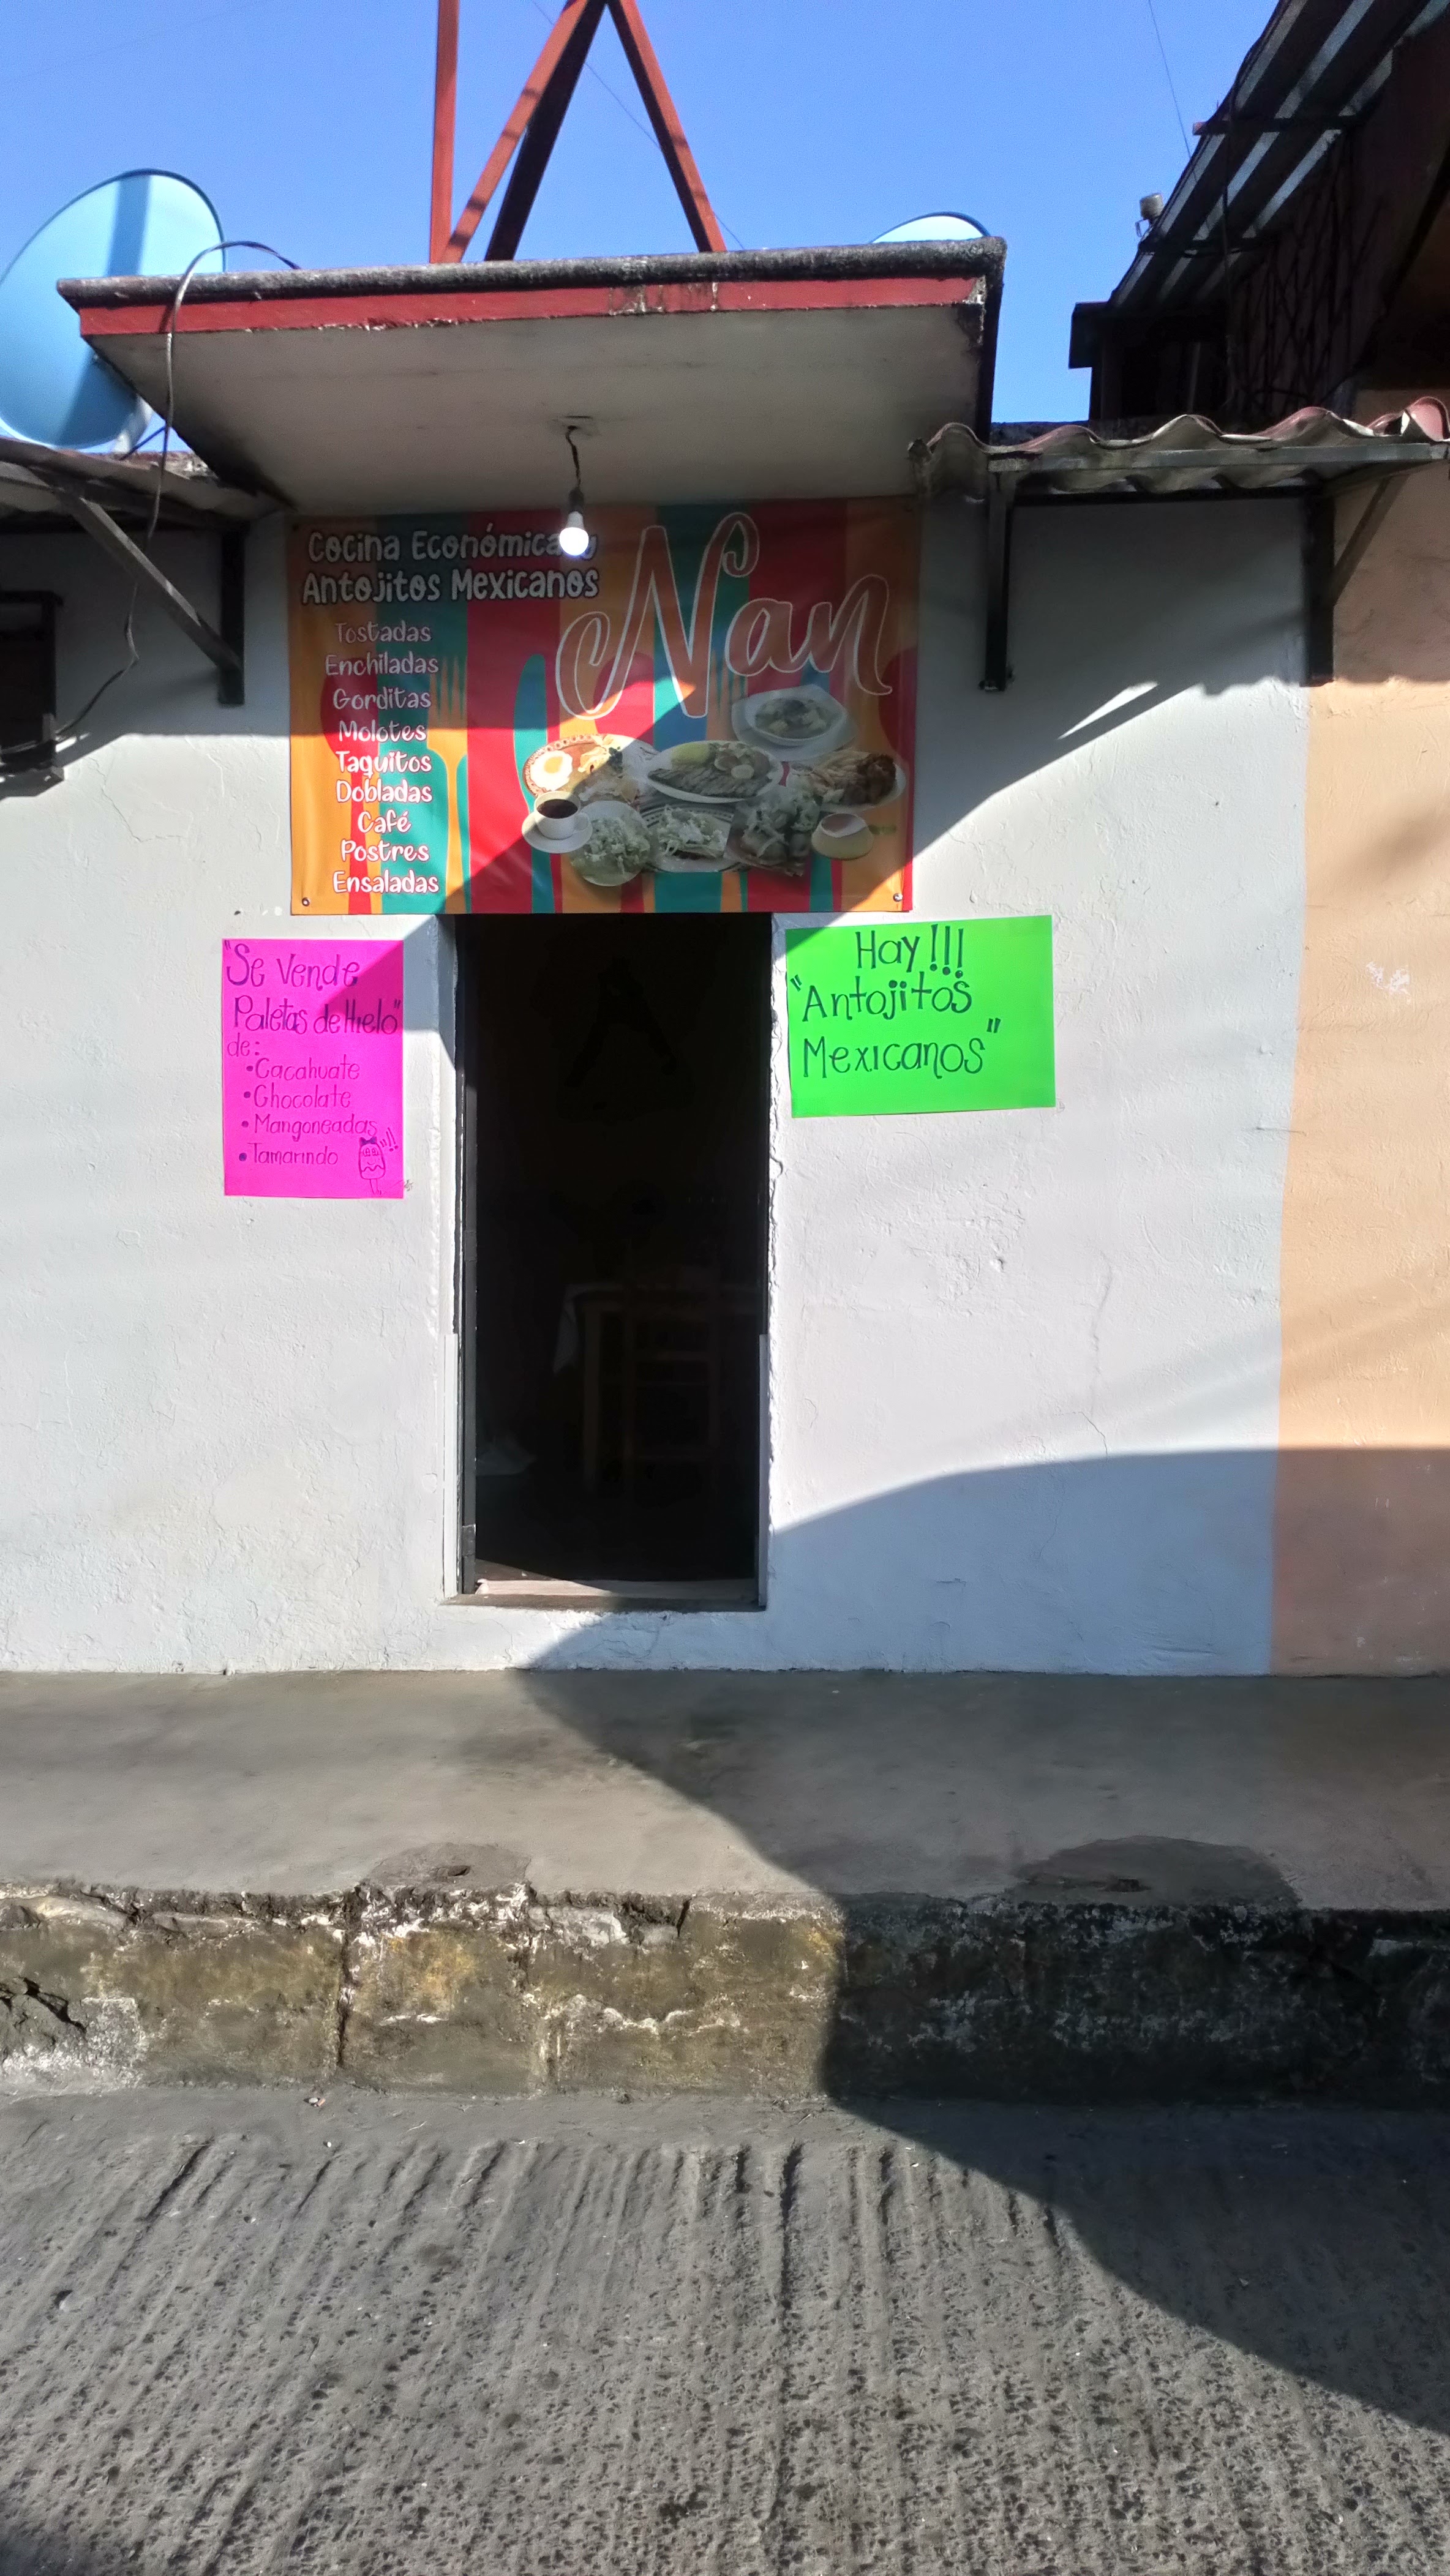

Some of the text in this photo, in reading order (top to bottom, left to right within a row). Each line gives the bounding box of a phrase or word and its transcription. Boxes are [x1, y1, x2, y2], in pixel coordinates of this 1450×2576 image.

[309, 531, 400, 562] Cocina
[412, 523, 562, 560] Económica
[303, 568, 599, 604] Antojitos Mexicanos
[555, 512, 893, 720] Nan
[335, 620, 432, 643] Tostadas
[325, 651, 439, 676] Enchiladas
[332, 687, 432, 710] Gorditas
[339, 720, 427, 743] Molotes
[336, 750, 432, 779] Taquitos
[336, 779, 433, 804] Dobladas
[357, 809, 411, 834] Café
[340, 839, 429, 862] Postres
[332, 872, 439, 894] Ensaladas
[276, 954, 360, 990] Vende
[235, 995, 307, 1035] Paletas
[314, 1003, 340, 1034] de
[255, 1054, 360, 1080] Cacahuate
[254, 1082, 351, 1109] Chocolate
[255, 1114, 378, 1142] Mangoneadas
[247, 1142, 339, 1165] Tamarindo
